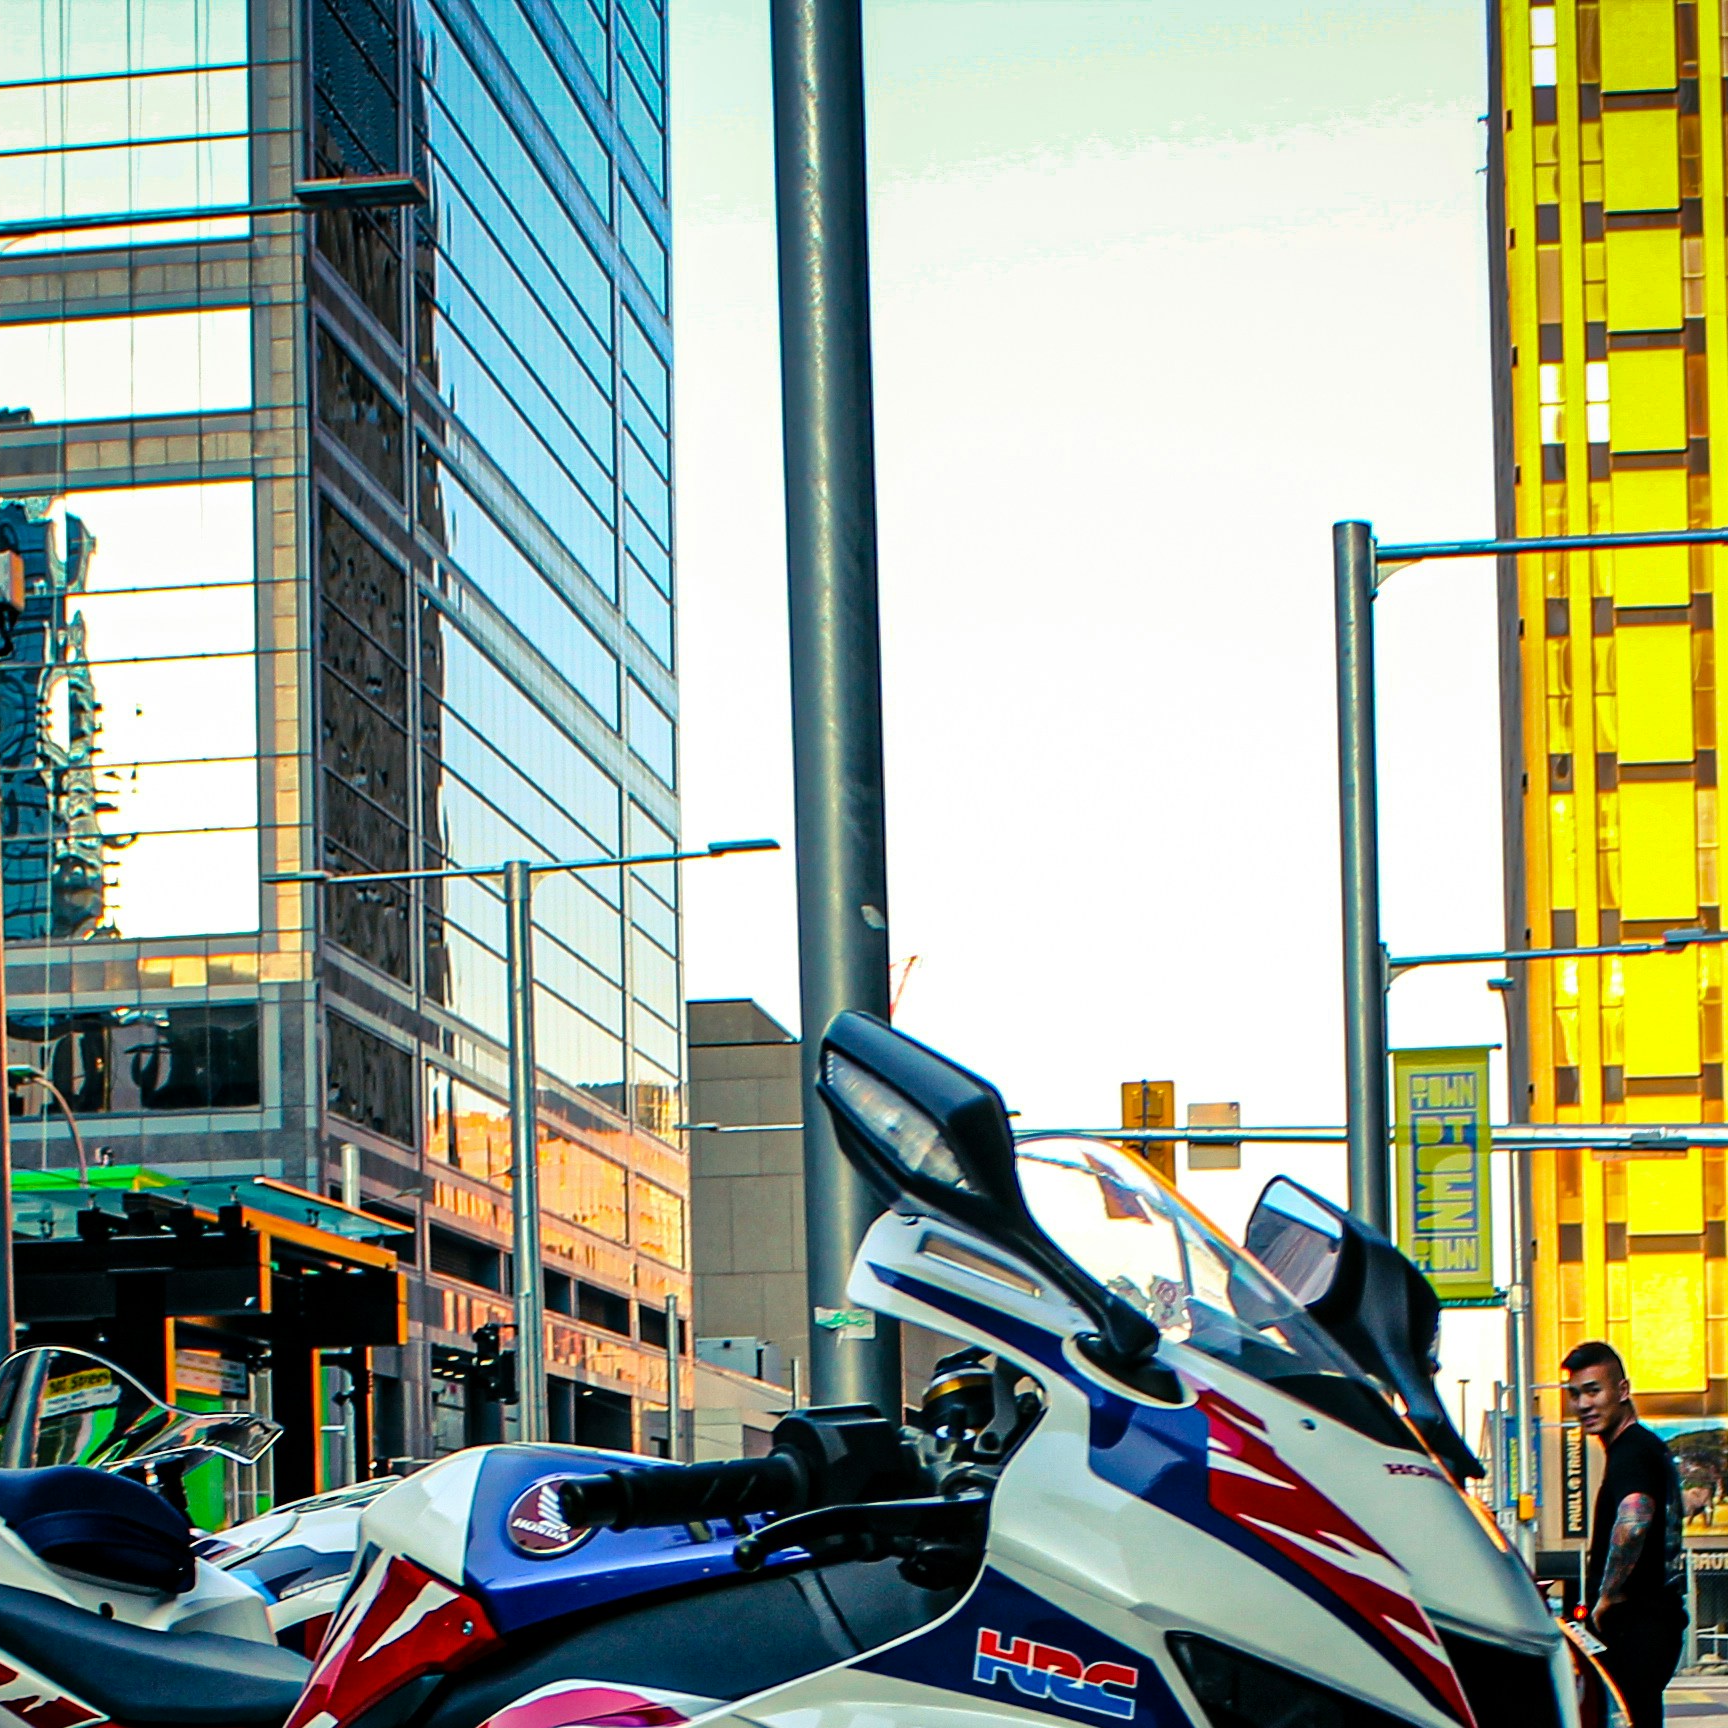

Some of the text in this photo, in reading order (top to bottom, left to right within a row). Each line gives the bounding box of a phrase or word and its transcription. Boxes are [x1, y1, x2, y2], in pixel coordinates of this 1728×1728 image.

[512, 1517, 570, 1543] HONDA
[1567, 1490, 1583, 1532] PAULL
[973, 1627, 1139, 1721] HRC
